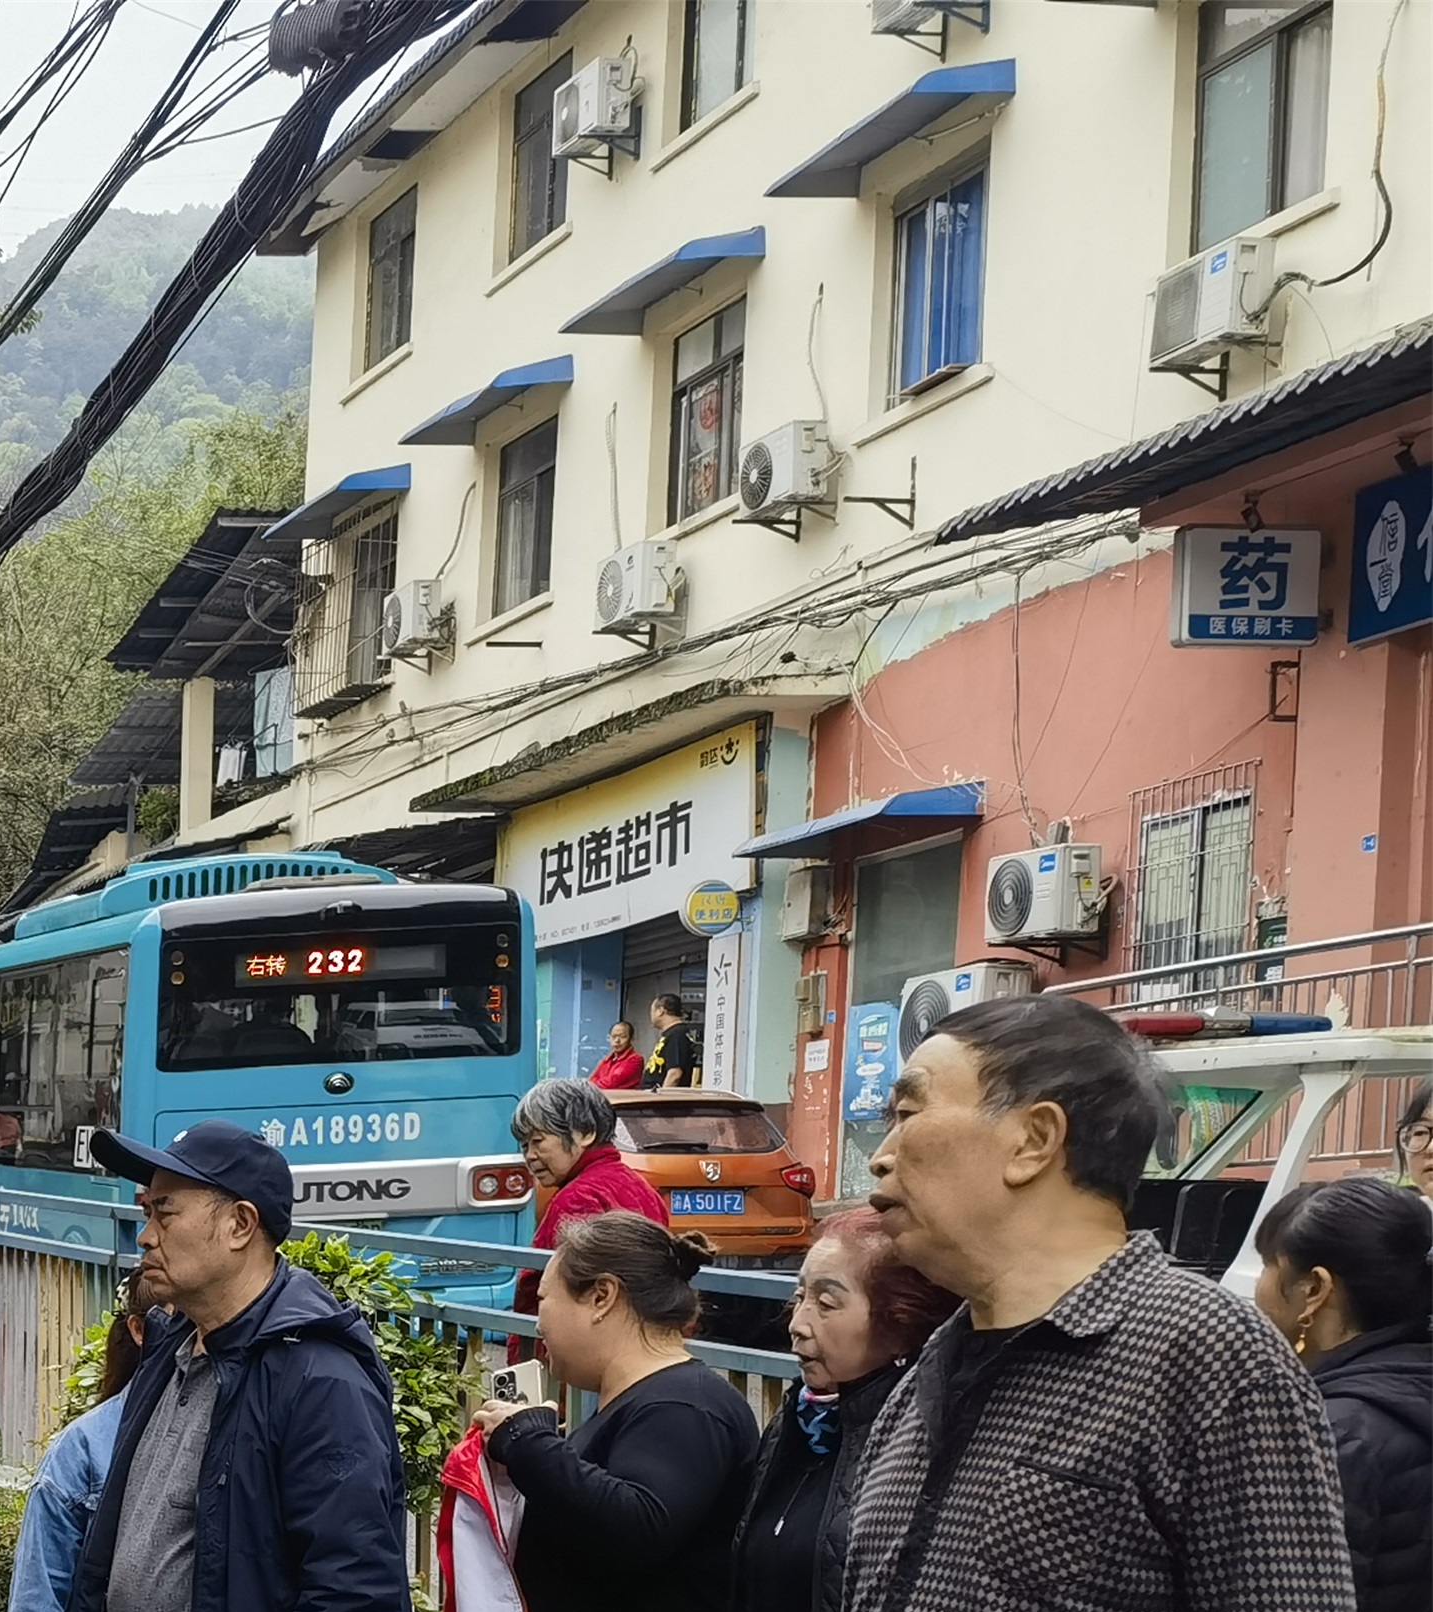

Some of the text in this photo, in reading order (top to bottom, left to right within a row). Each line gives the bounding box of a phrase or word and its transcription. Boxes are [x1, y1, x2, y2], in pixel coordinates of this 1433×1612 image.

[1219, 535, 1291, 612] 药
[1209, 615, 1295, 636] 医保刷卡
[539, 800, 693, 906] 快递超市
[694, 908, 733, 921] 便利店
[245, 947, 365, 978] 右转 232
[260, 1111, 422, 1147] 渝A18936D
